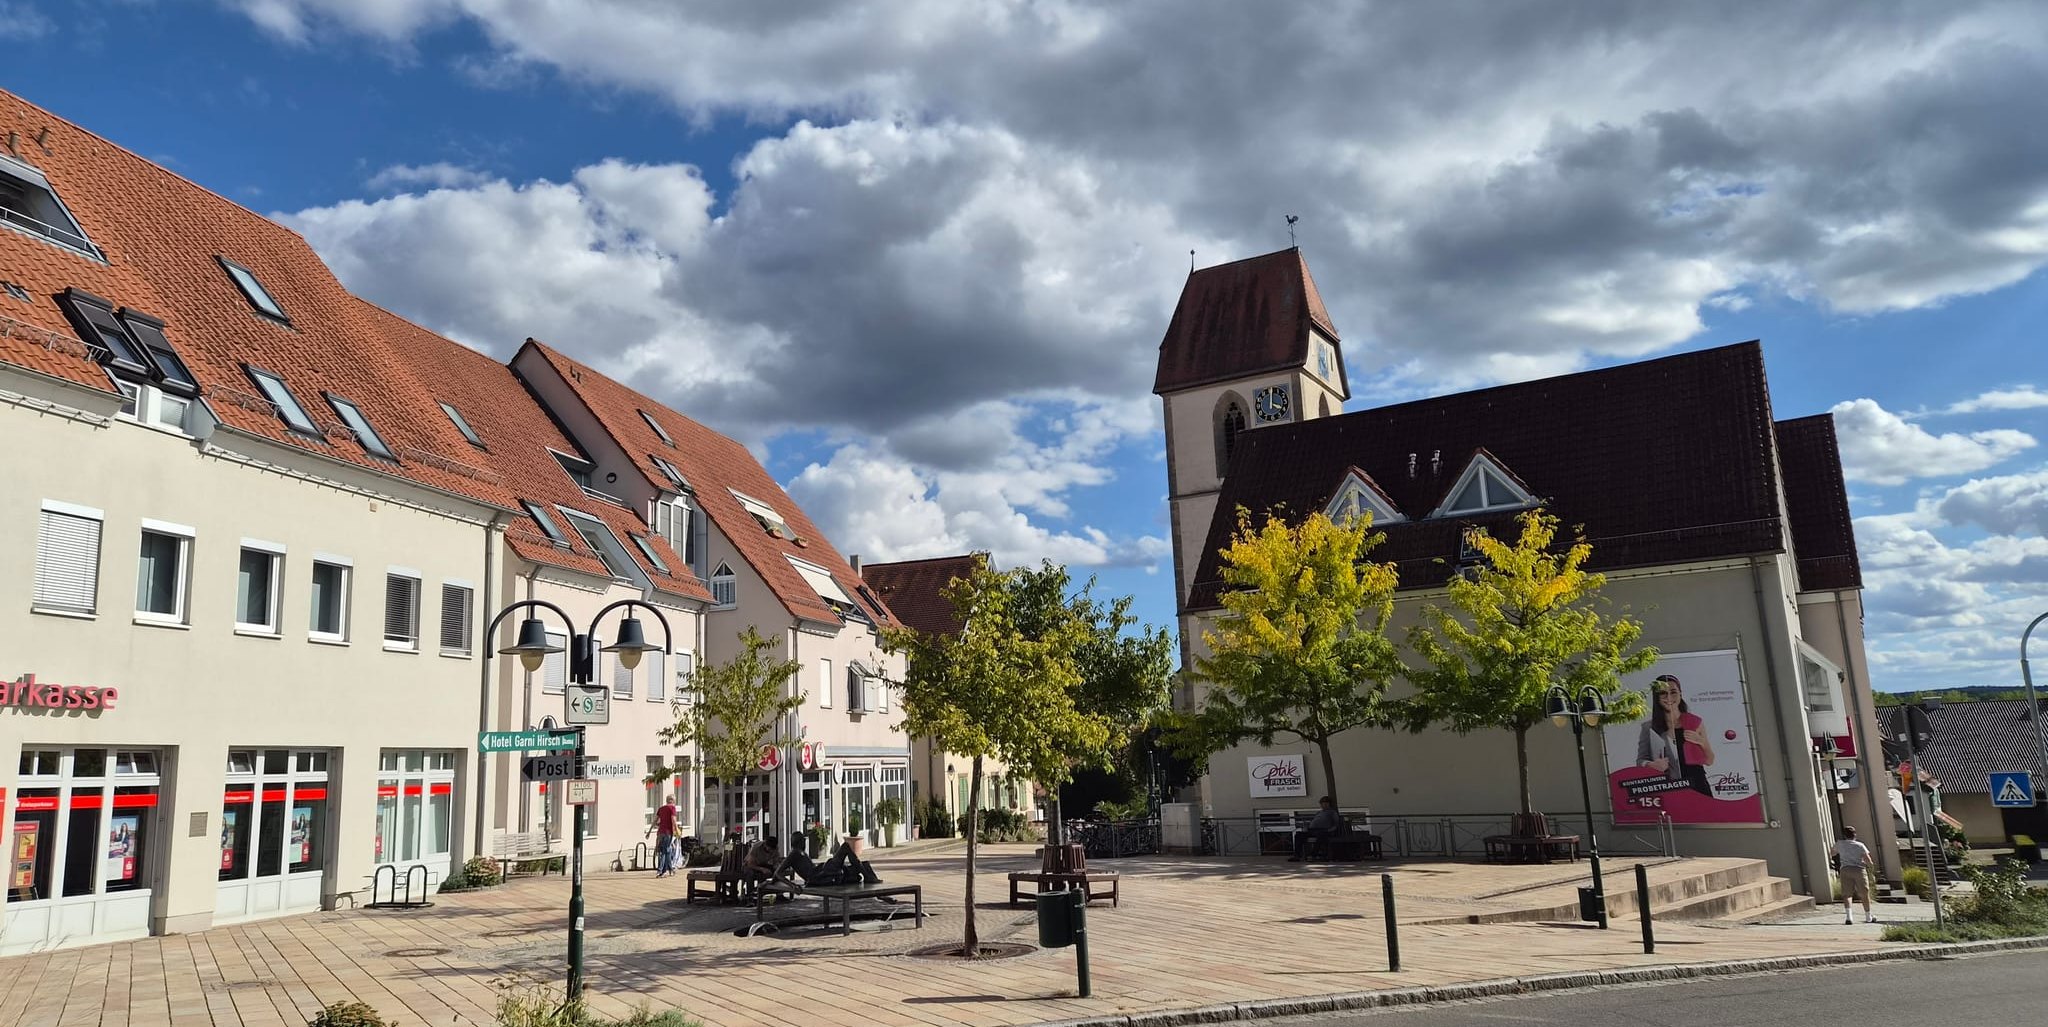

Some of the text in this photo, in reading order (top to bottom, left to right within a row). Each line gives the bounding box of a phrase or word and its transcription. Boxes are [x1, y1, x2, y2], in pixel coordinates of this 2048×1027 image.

[491, 734, 561, 748] Hotel Garni Hirsch
[537, 760, 569, 777] Post
[591, 763, 631, 778] Marktplatz
[1270, 778, 1301, 786] FRASCH
[1632, 780, 1690, 794] PROBETRAGEN
[1639, 797, 1661, 807] 15€
